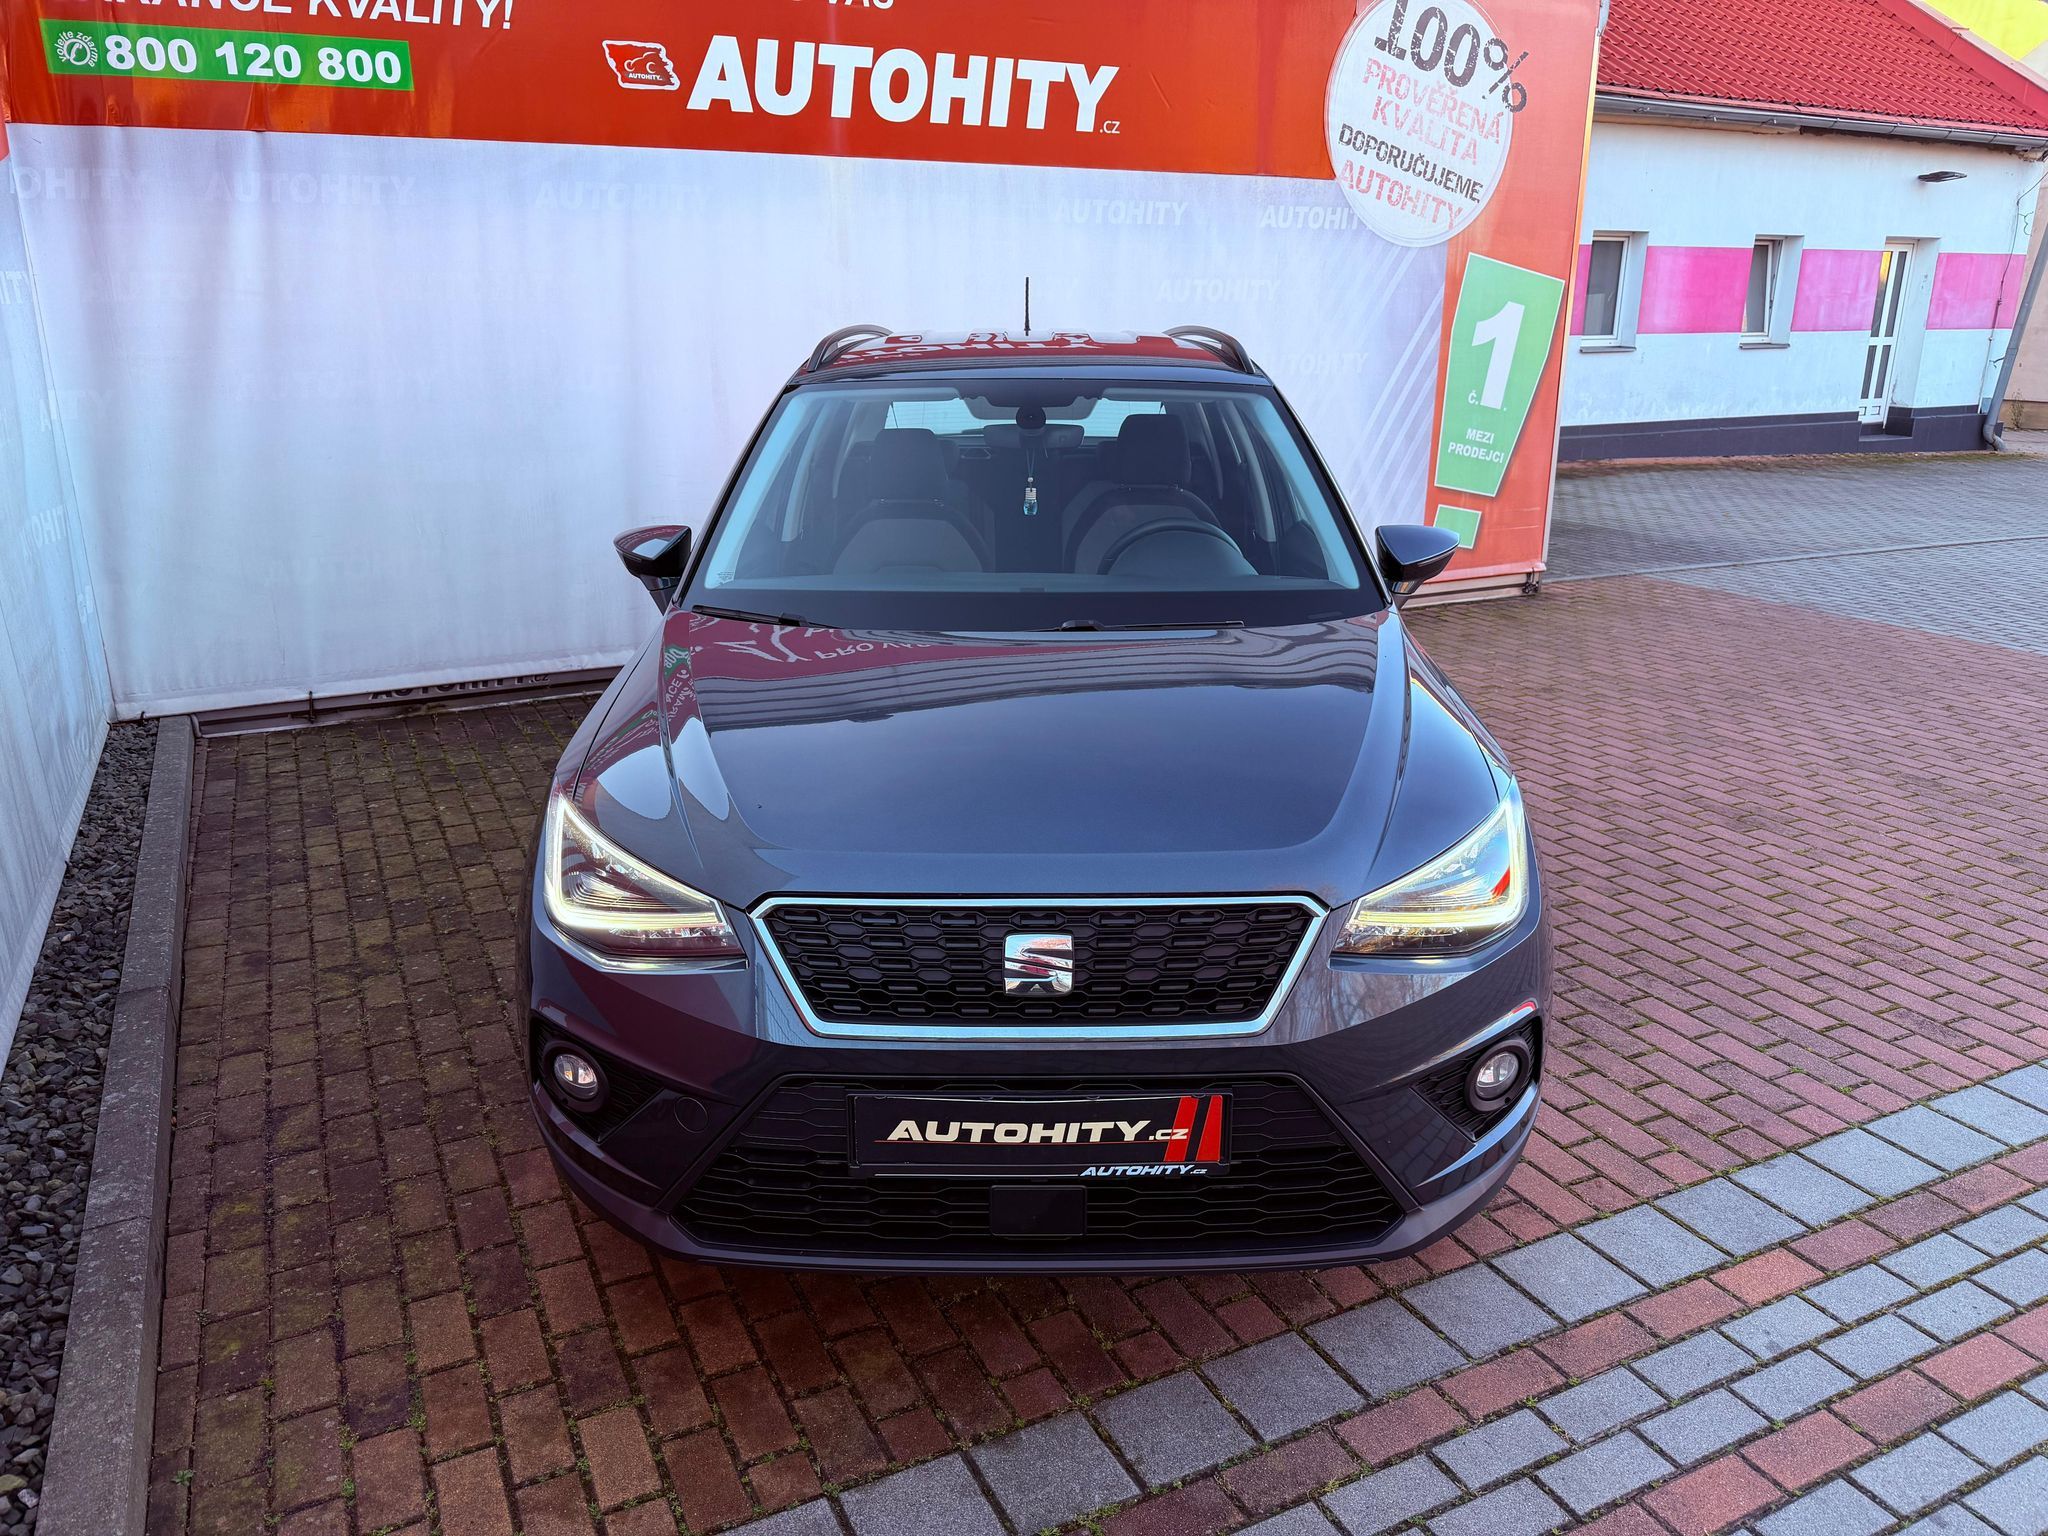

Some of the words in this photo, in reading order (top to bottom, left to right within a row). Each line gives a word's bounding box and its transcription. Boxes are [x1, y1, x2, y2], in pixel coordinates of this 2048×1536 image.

[76, 31, 98, 67] zdarma
[105, 35, 197, 73] 800
[215, 41, 301, 79] 120
[317, 47, 402, 84] 800
[1374, 0, 1529, 113] 100%
[1362, 58, 1503, 144] PROVĚŘENÁ
[1371, 95, 1478, 166] KVALITA
[1338, 123, 1484, 204] DOPORUČUJEME
[1053, 197, 1190, 227] AUTOHITY
[1340, 159, 1464, 231] AUTOHITY
[1157, 278, 1281, 304] AUTOHITY
[1448, 441, 1505, 464] PRODEJCI
[1466, 428, 1495, 445] MEZI
[887, 1119, 1189, 1144] AUTOHITY.cz
